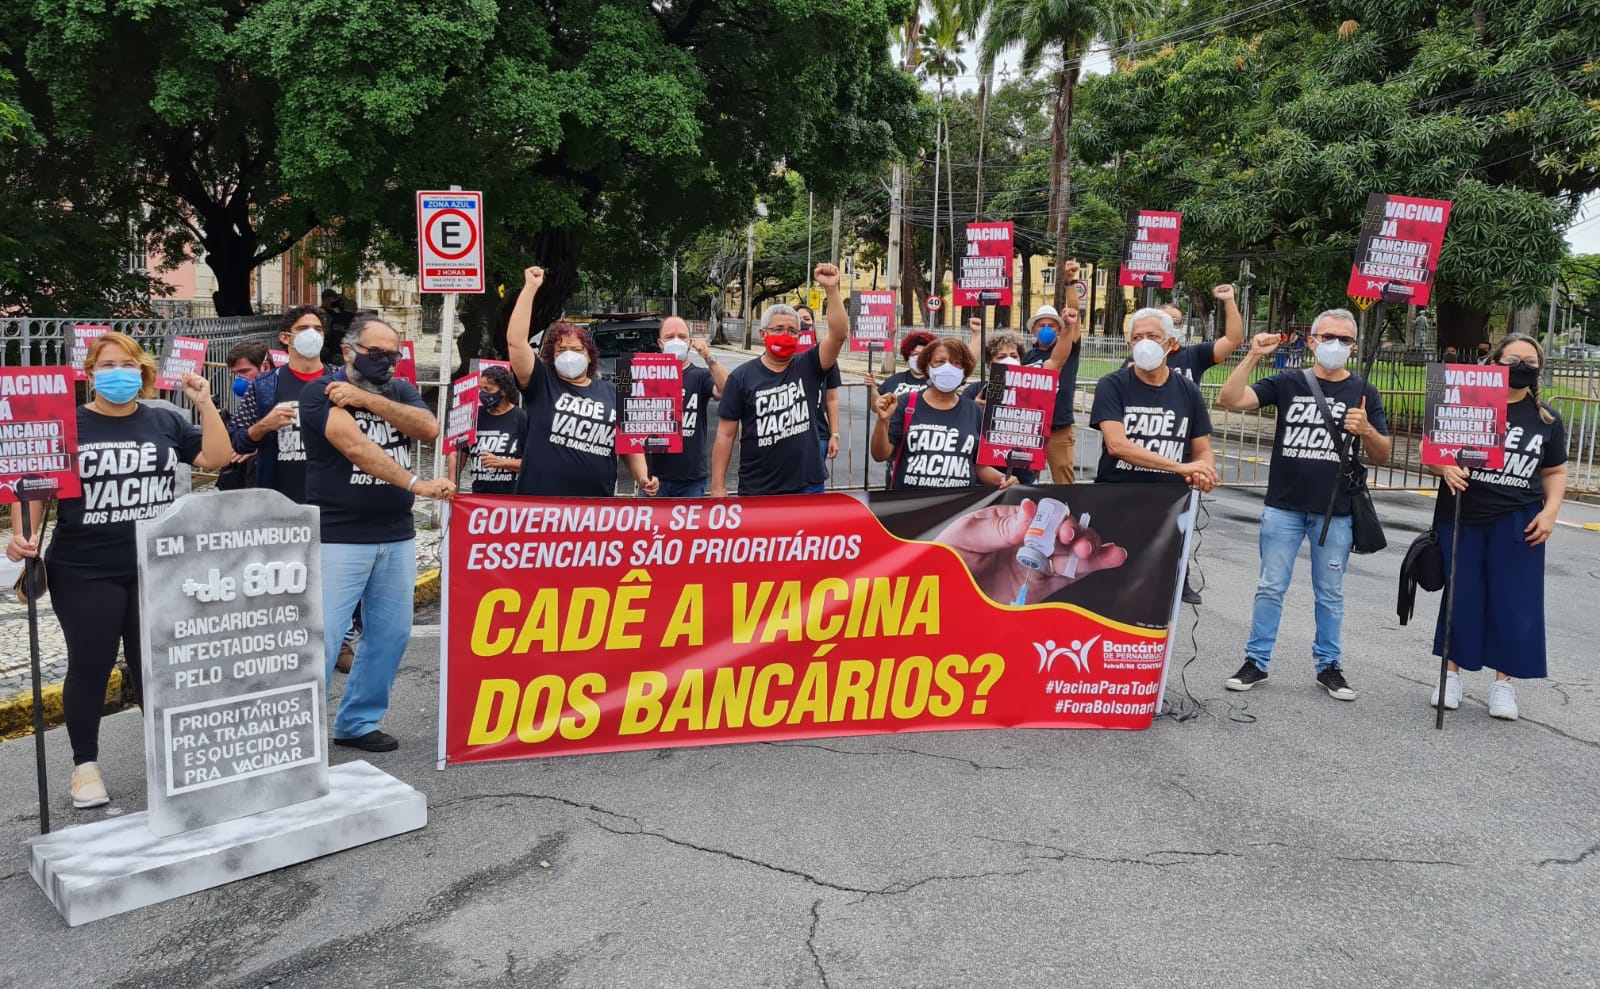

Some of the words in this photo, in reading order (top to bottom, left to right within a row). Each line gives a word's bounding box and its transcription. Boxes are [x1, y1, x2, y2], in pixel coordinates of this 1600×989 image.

[1385, 201, 1443, 223] VACINA
[1138, 215, 1177, 229] VACINA
[1380, 219, 1398, 237] JÁ
[441, 221, 461, 248] E
[966, 228, 1009, 240] VACINA
[1136, 227, 1148, 241] JÁ
[967, 241, 979, 256] JÁ
[1372, 239, 1427, 256] BANCÁRIO
[1370, 251, 1415, 267] TAMBÉM
[1363, 264, 1425, 282] ESSENCIAL!
[961, 279, 1006, 288] ESSENCIAL!
[860, 294, 891, 304] VACINA
[272, 353, 289, 363] CINA
[631, 365, 678, 379] VACINA
[1005, 370, 1053, 391] VACINA
[1445, 370, 1503, 388] VACINA
[0, 374, 68, 395] ACINA
[631, 380, 645, 396] JÁ
[1001, 387, 1016, 405] JÁ
[1443, 386, 1461, 403] JÁ
[0, 397, 13, 420] Á
[627, 399, 671, 409] BANCÁRIO
[1438, 406, 1493, 419] BANCÁRIO
[628, 410, 664, 421] TAMBÉM
[996, 407, 1041, 422] BANCÁRIO
[0, 422, 59, 439] NCÁRIO
[625, 422, 674, 433] ESSENCIAL!
[995, 420, 1033, 434] TAMBÉM
[1123, 410, 1176, 437] CADÊ
[1176, 417, 1189, 438] A
[1438, 419, 1483, 432] TAMBÉM
[0, 438, 48, 456] MBÉM
[473, 432, 510, 454] ADÊ
[550, 434, 567, 446] DOS
[758, 436, 772, 447] DOS
[907, 428, 960, 453] CADÊ
[960, 434, 975, 455] A
[989, 433, 1040, 447] ESSENCIAL!
[1434, 432, 1495, 446] ESSENCIAL!
[1525, 434, 1543, 454] A
[78, 442, 157, 479] CADÊ
[164, 447, 178, 471] A
[1282, 447, 1298, 458] DOS
[0, 455, 65, 474] SENCIAL!
[350, 474, 374, 485] DOS
[904, 474, 918, 486] DOS
[83, 476, 173, 510] VACINA
[83, 511, 109, 525] DOS
[467, 505, 660, 535] GOVERNADOR,
[669, 505, 705, 531] SE
[708, 503, 743, 530] OS
[156, 535, 185, 556] EM
[196, 526, 311, 551] PERNAMBUCO
[467, 541, 623, 570] ESSENCIAIS
[629, 532, 683, 566] SÃO
[688, 530, 862, 564] PRIORITÁRIOS
[242, 561, 308, 597] 800
[470, 569, 653, 657] CADÊ
[660, 583, 704, 648] A
[732, 574, 942, 645] VACINA
[168, 628, 309, 665] INFECTADOS(AS)
[175, 666, 222, 689] PELO
[233, 652, 299, 679] COVID19
[466, 671, 607, 746] DOS
[618, 643, 1006, 735] BANCÁRIOS?
[1046, 680, 1160, 696] #VacinaParaTodo
[179, 697, 300, 731] PRIORITÁRIOS
[1055, 700, 1155, 715] #ForaBolsonar
[172, 731, 210, 752] PRA
[214, 711, 312, 741] TRABALHAR
[184, 731, 300, 767] ESQUECIDOS
[184, 768, 222, 785] PRA
[232, 747, 303, 775] VACINAR
